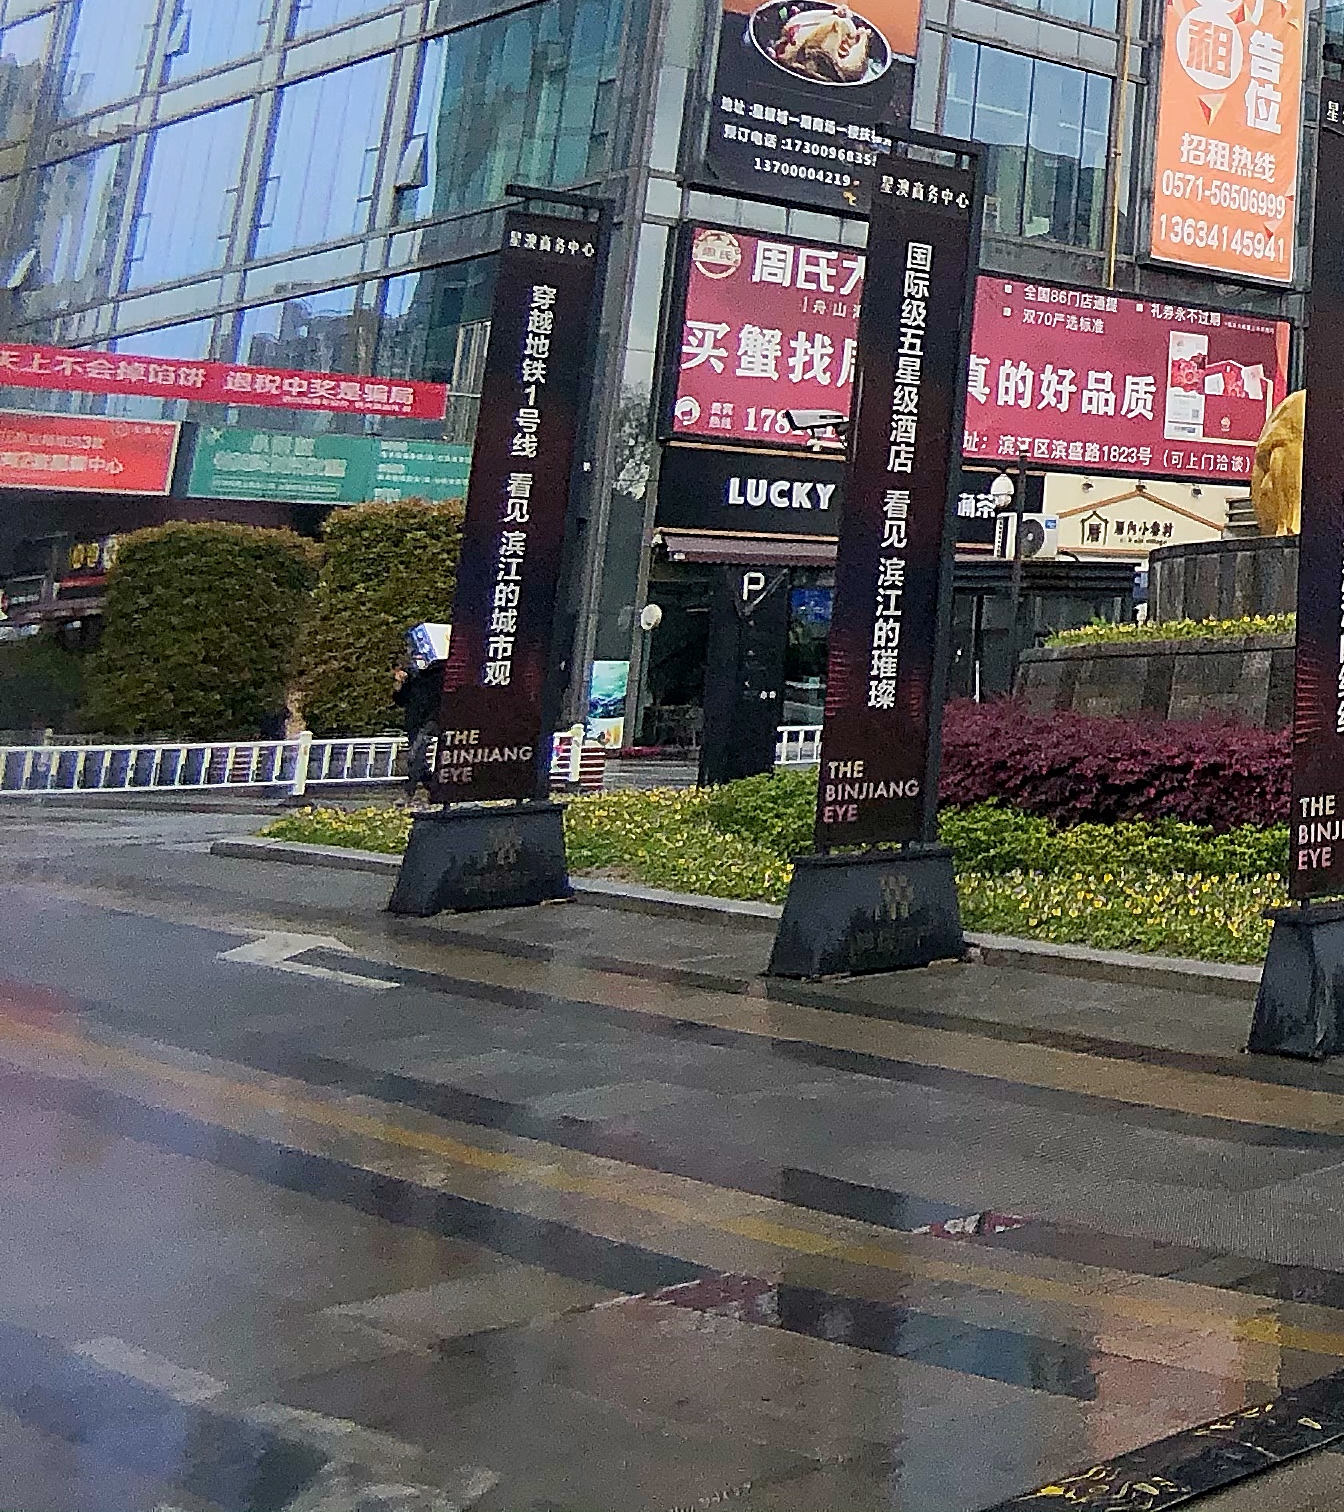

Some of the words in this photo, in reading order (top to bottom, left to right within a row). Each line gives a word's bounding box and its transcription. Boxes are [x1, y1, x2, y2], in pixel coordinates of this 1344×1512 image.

[1180, 132, 1276, 183] 招租热线
[880, 175, 970, 209] 星澳商务中心
[1162, 169, 1286, 220] 0571-56506999
[1160, 212, 1285, 264] 13634145941
[1022, 308, 1105, 334] 双70严选标准
[510, 285, 558, 458] 穿越地铁1号线
[887, 242, 933, 473] 国际级五星级酒店
[967, 354, 1157, 422] 真的好品质
[503, 472, 534, 523] 看见
[728, 477, 836, 511] LUCKY
[881, 489, 911, 548] 看见
[743, 573, 765, 600] P
[484, 530, 527, 686] 滨江的城市观
[868, 557, 906, 709] 滨江的璀璨
[445, 730, 480, 746] THE
[440, 746, 534, 765] BINJIANG
[828, 761, 865, 779] THE
[438, 766, 474, 784] EYE
[825, 779, 920, 802] BINJIANG
[823, 804, 858, 824] EYE
[1299, 794, 1336, 818] THE
[1298, 846, 1332, 871] EYE
